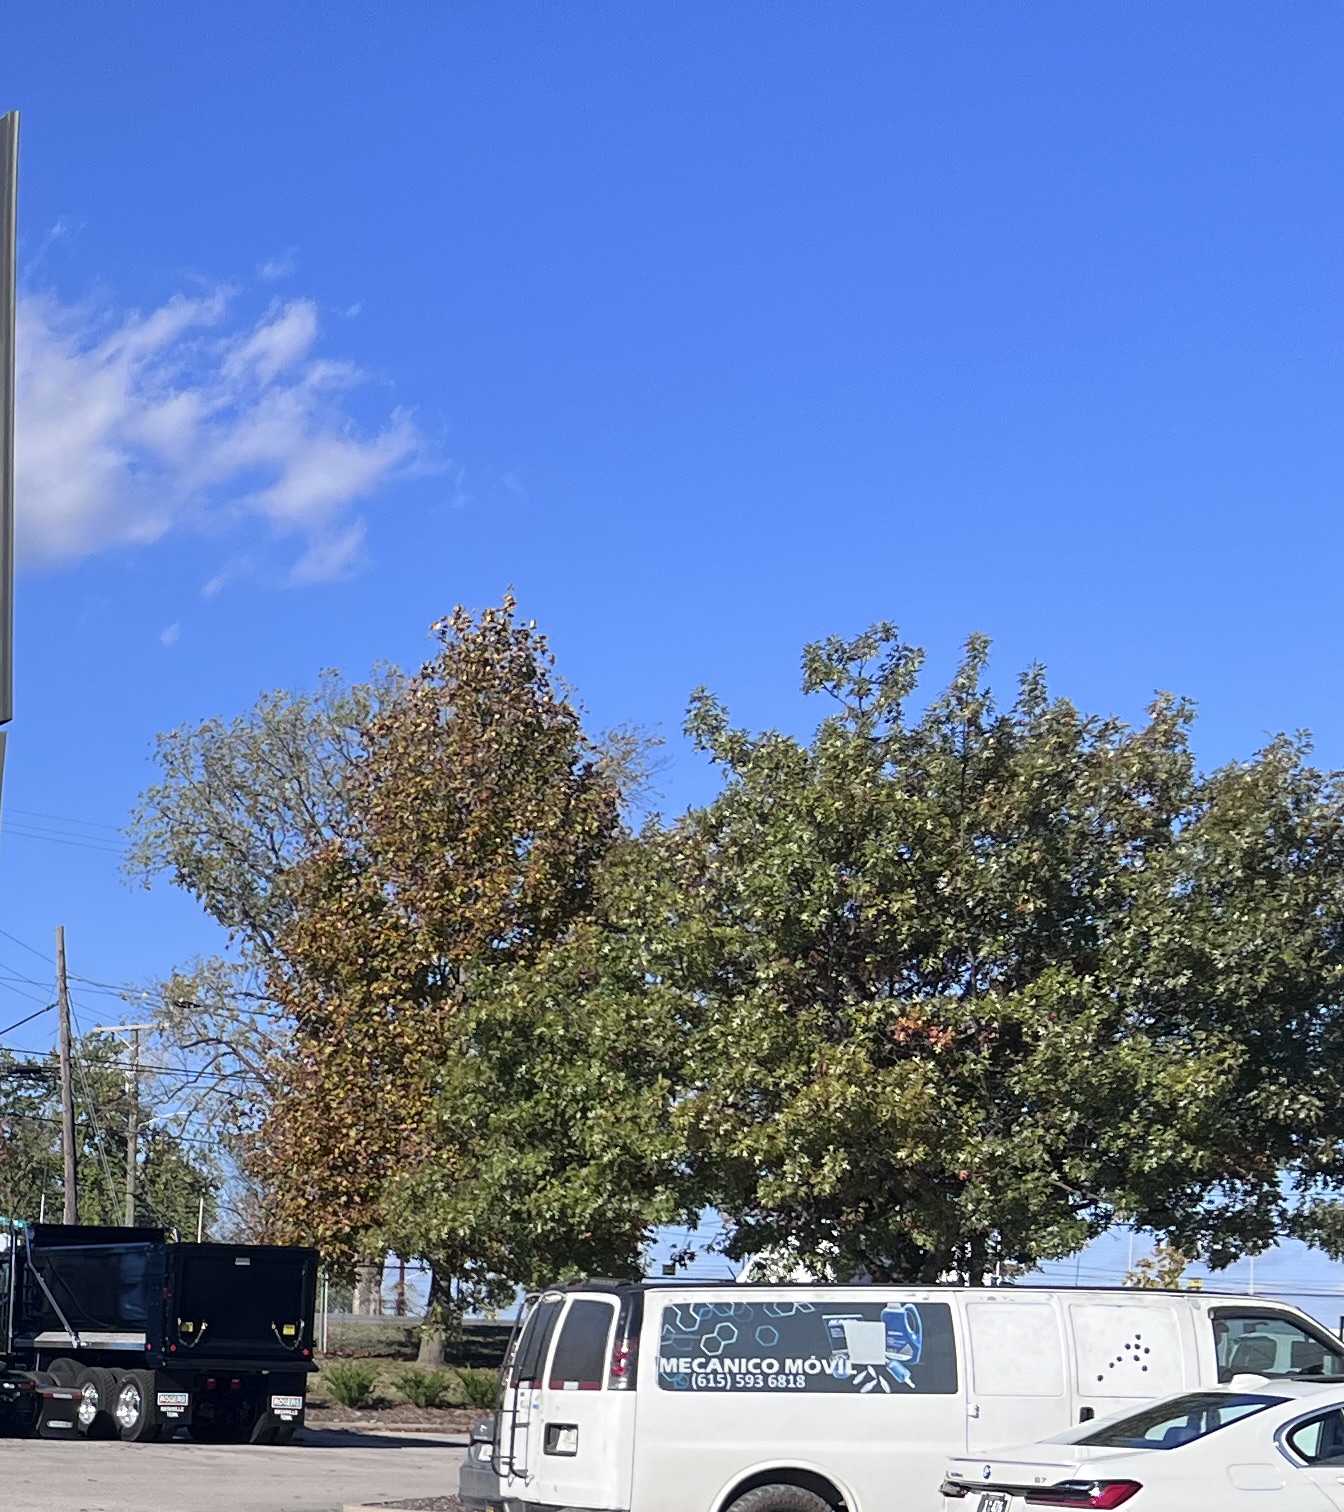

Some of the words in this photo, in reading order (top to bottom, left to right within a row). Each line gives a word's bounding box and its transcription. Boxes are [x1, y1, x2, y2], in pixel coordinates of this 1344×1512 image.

[659, 1357, 779, 1375] MECANICO
[691, 1374, 732, 1390] (615)
[736, 1375, 764, 1388] 593
[768, 1375, 806, 1388] 6818
